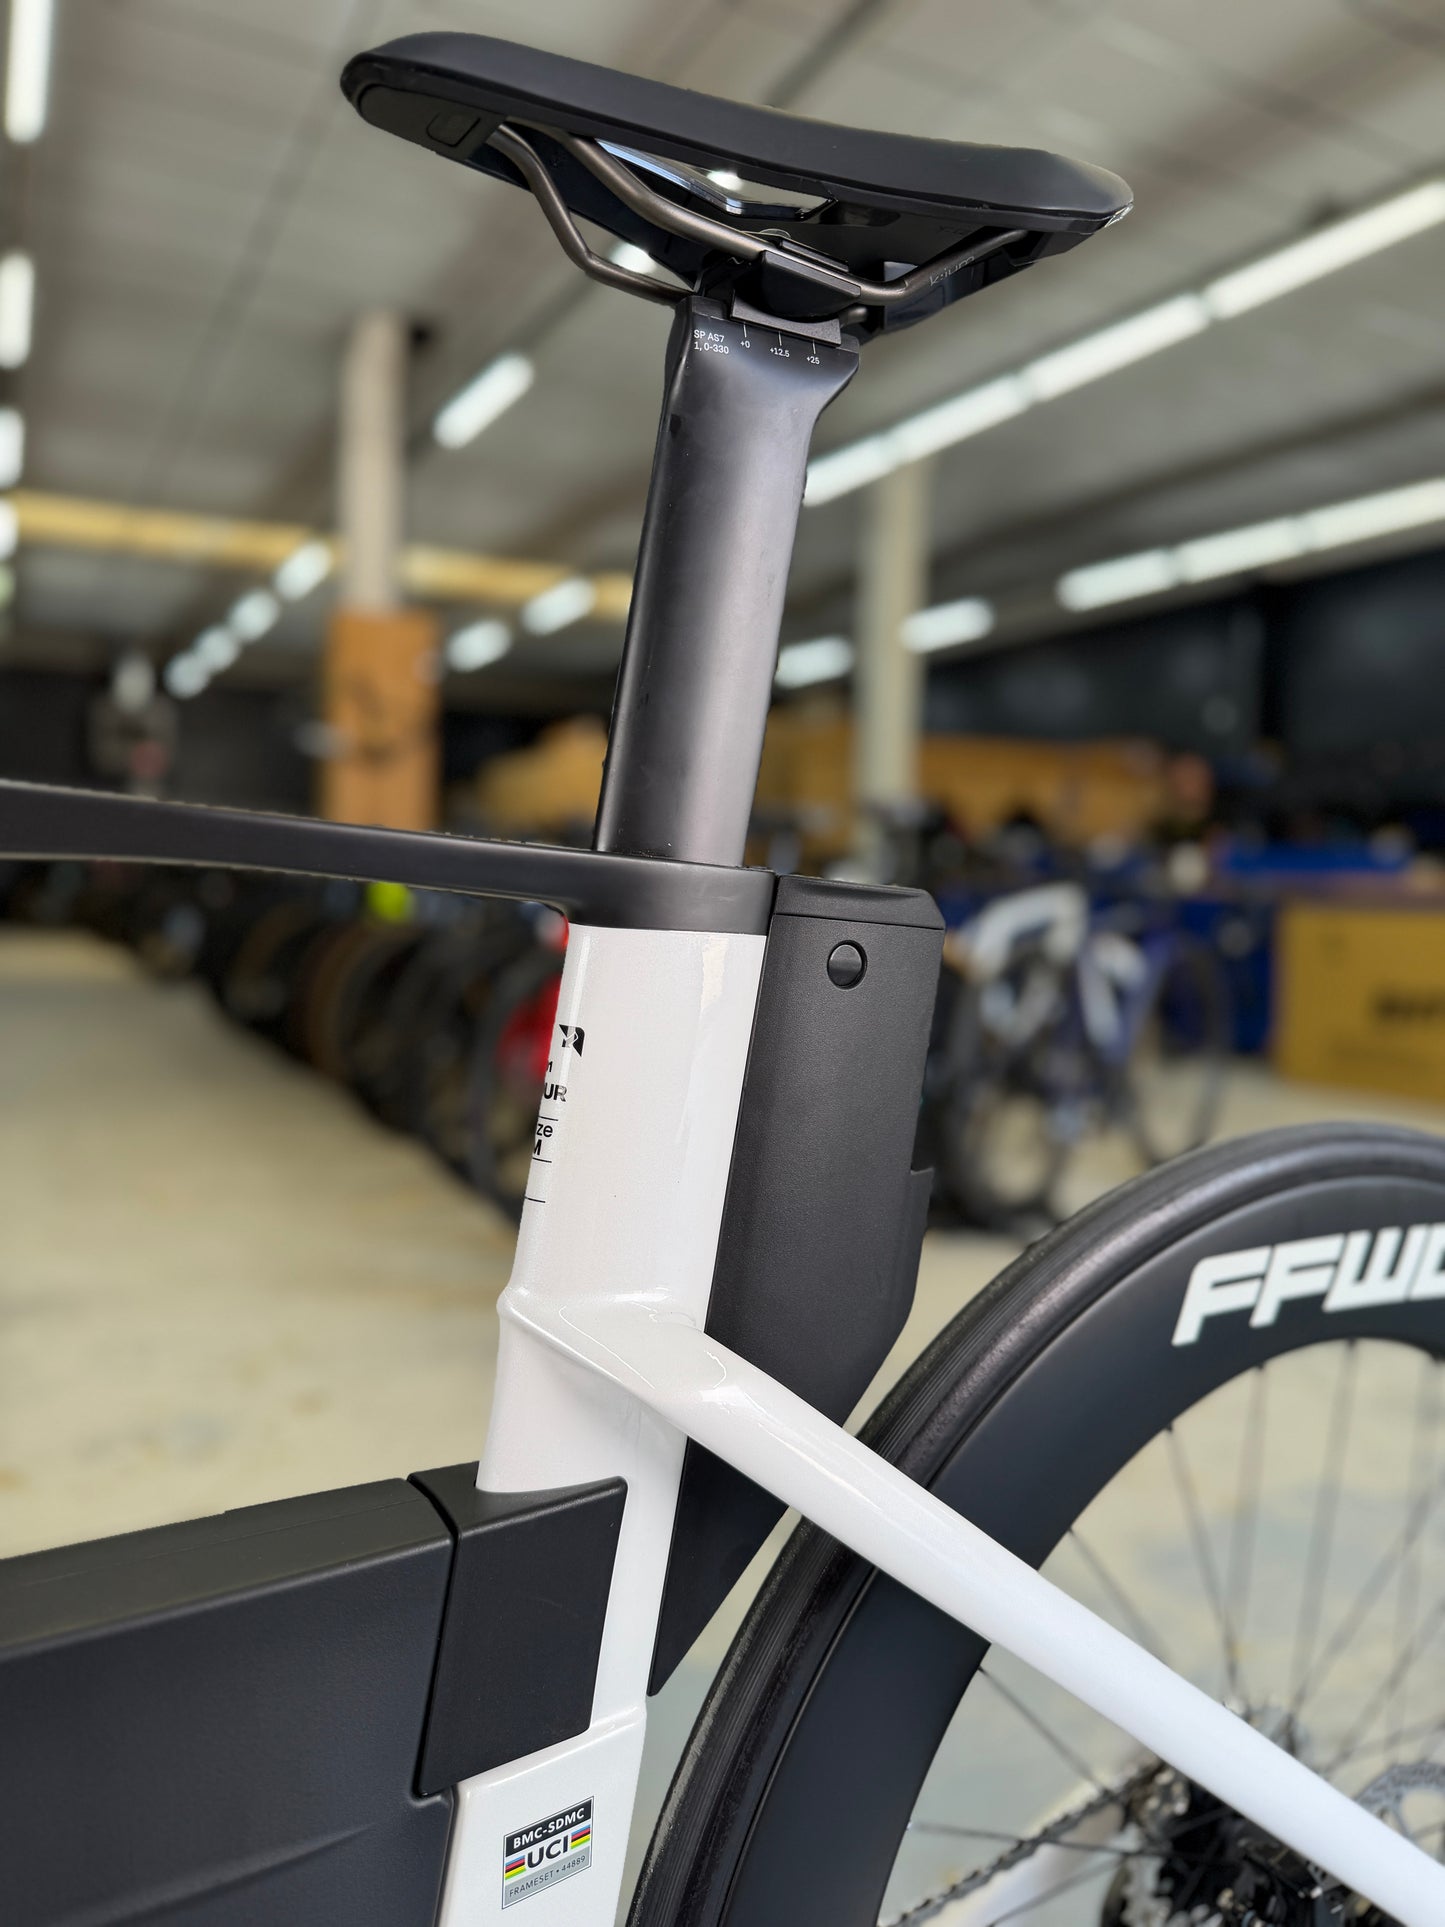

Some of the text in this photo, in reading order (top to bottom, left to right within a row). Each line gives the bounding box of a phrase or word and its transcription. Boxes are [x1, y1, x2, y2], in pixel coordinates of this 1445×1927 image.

[693, 329, 725, 343] SP AS7
[740, 340, 751, 349] +0
[769, 347, 790, 358] +12.5
[806, 356, 820, 365] +25
[513, 1807, 585, 1850] BMC-SDMC
[527, 1834, 569, 1870] UCI
[509, 1870, 554, 1898] FRAMESET
